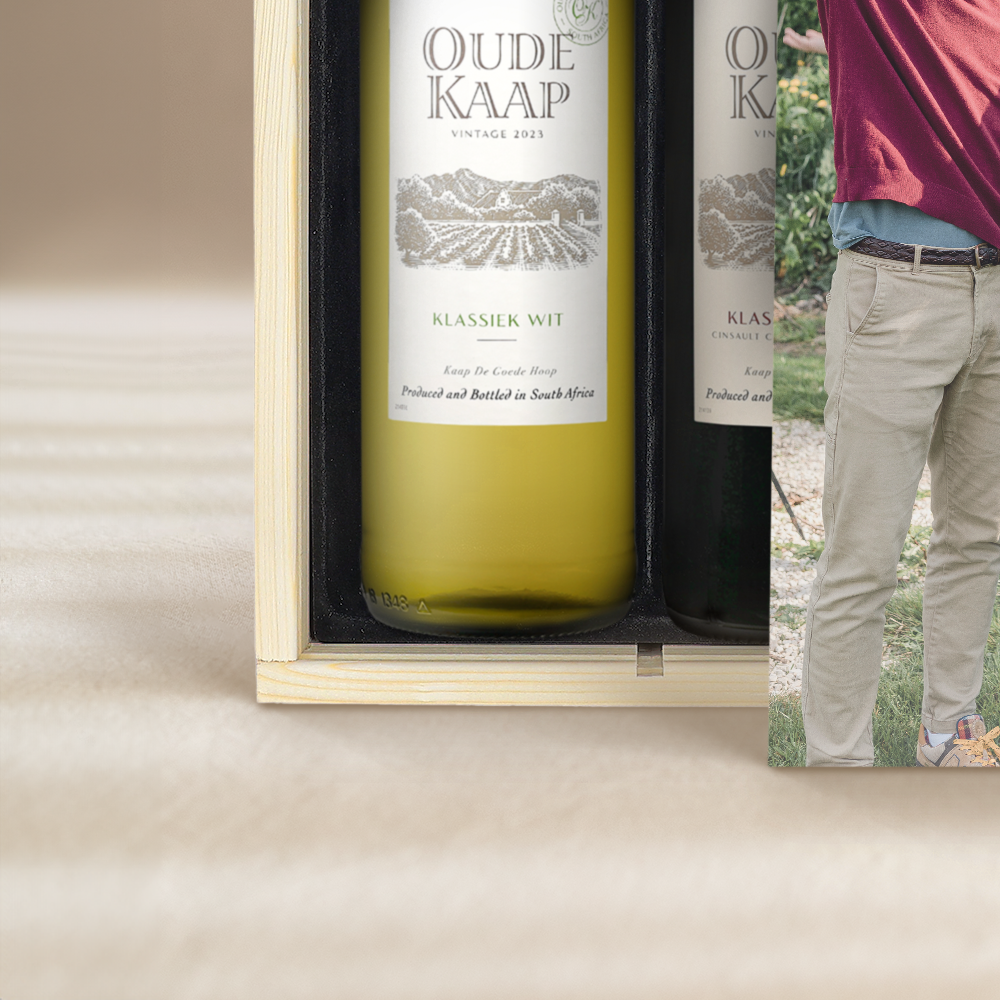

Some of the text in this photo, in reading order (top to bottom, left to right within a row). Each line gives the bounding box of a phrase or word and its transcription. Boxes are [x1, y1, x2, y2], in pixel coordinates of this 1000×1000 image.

[422, 26, 575, 71] OUDE
[427, 75, 570, 119] KAAP
[451, 129, 544, 139] VINTAGE 2023
[433, 312, 564, 327] KLASSIEK WIT
[728, 311, 772, 326] KLAS
[711, 330, 760, 341] CINSAULT
[443, 365, 558, 379] Kaap De Goede Hoop
[744, 366, 771, 379] Kaap
[401, 385, 595, 402] Produced and Bottled in South Africa
[705, 387, 773, 402] Produced and
